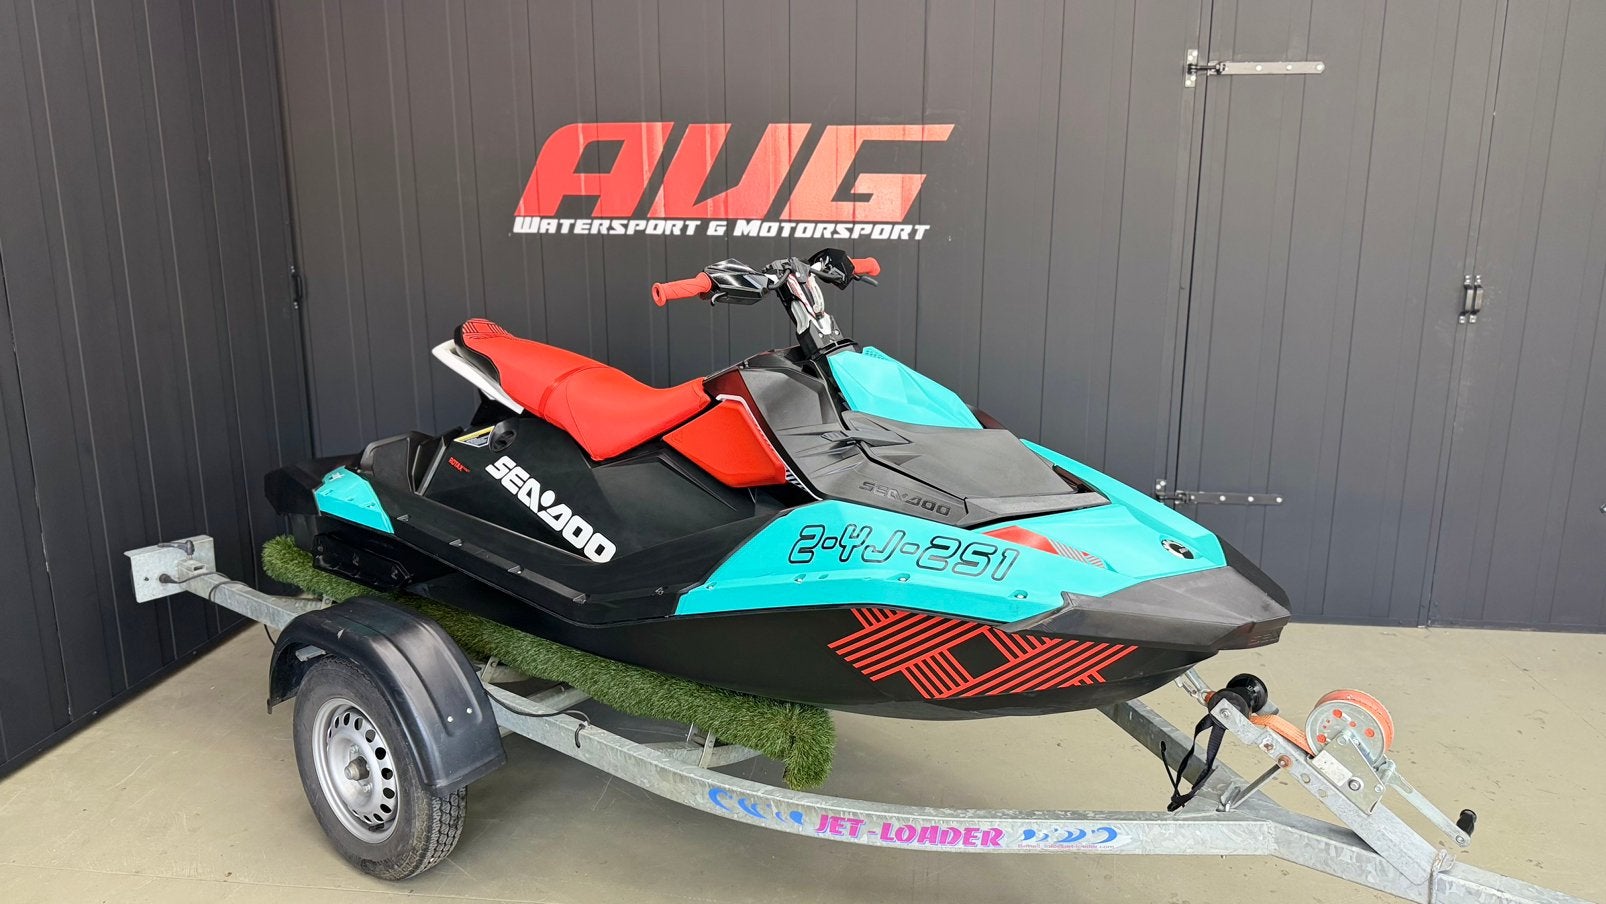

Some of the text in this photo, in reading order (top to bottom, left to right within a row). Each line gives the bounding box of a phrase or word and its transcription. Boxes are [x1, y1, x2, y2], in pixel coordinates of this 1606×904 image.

[513, 122, 955, 222] AUG
[513, 217, 699, 235] WATERSPORT
[733, 221, 930, 240] MOTORSPORT
[815, 815, 1006, 847] JET-LOADER
